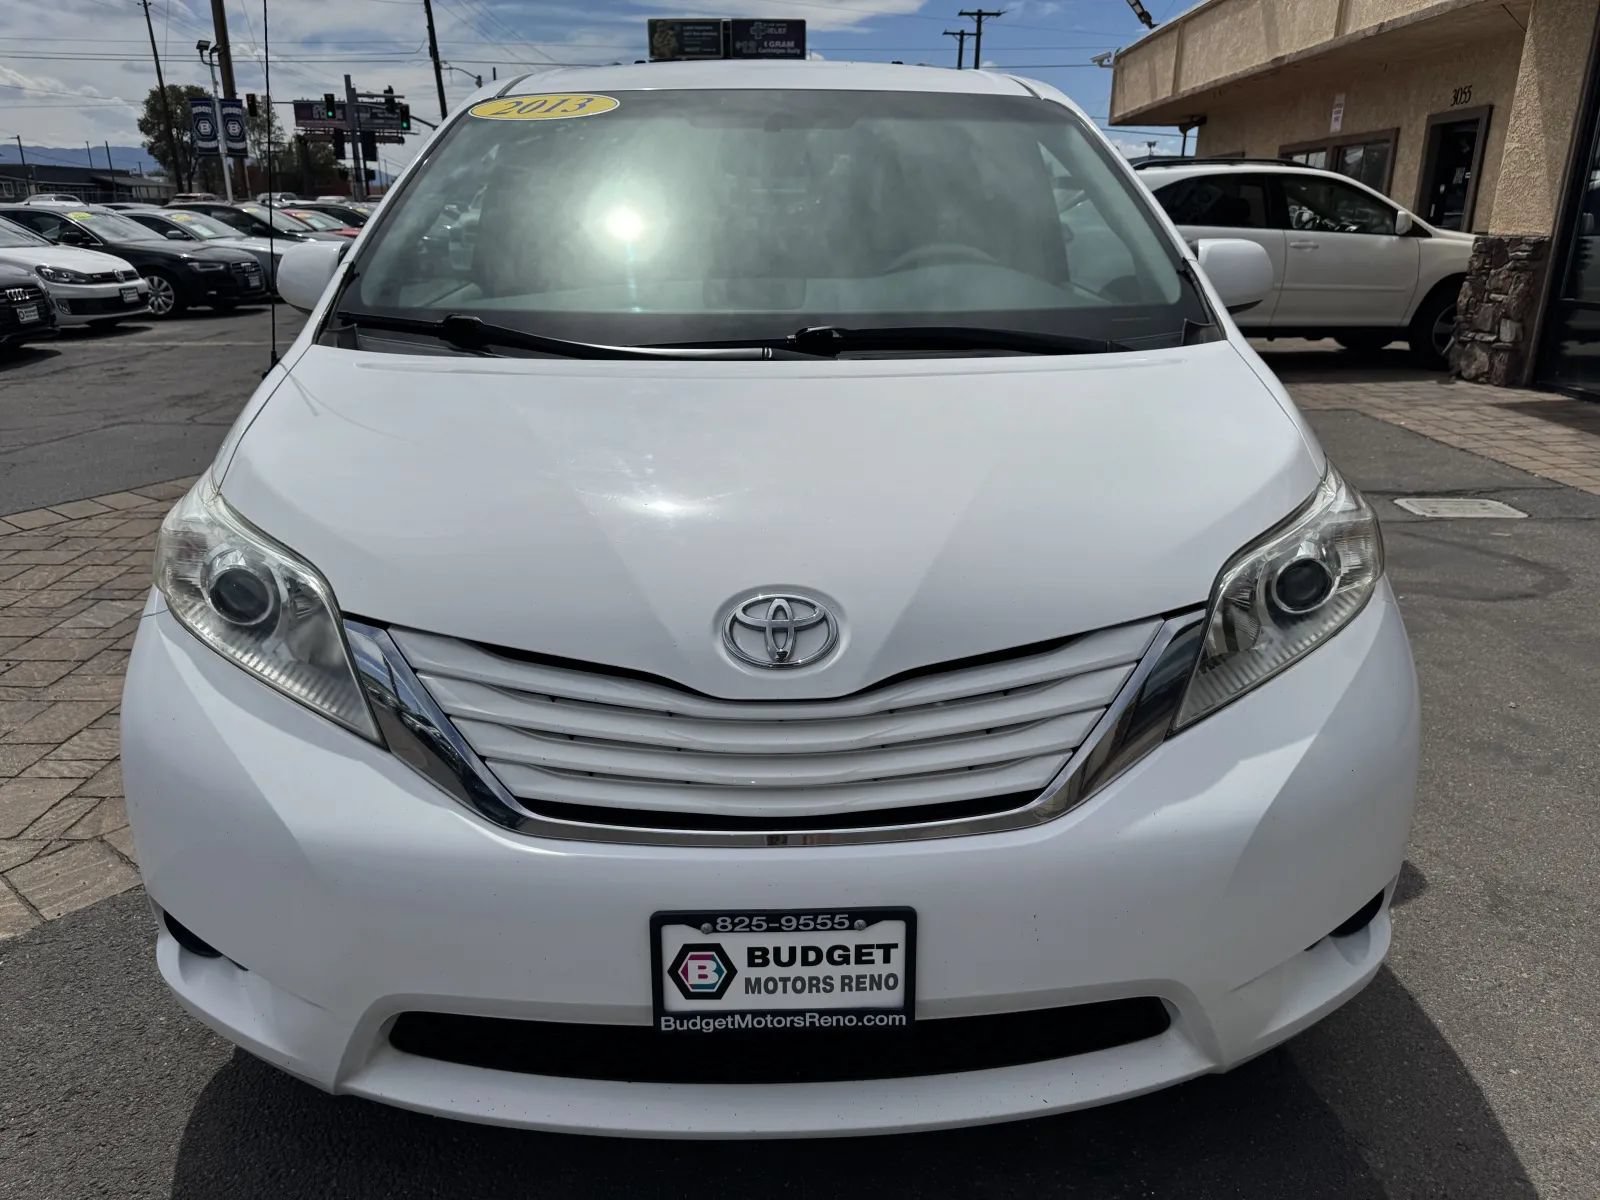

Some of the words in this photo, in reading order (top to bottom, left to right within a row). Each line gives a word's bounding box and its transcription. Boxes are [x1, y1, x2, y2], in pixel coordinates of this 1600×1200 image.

[1451, 85, 1472, 106] 3055
[488, 98, 594, 116] 2013
[715, 914, 850, 932] 825-9555
[746, 943, 899, 968] BUDGET
[744, 975, 835, 995] MOTORS
[840, 973, 899, 992] RENO
[660, 1012, 907, 1033] BudgetMotorsReno.com
